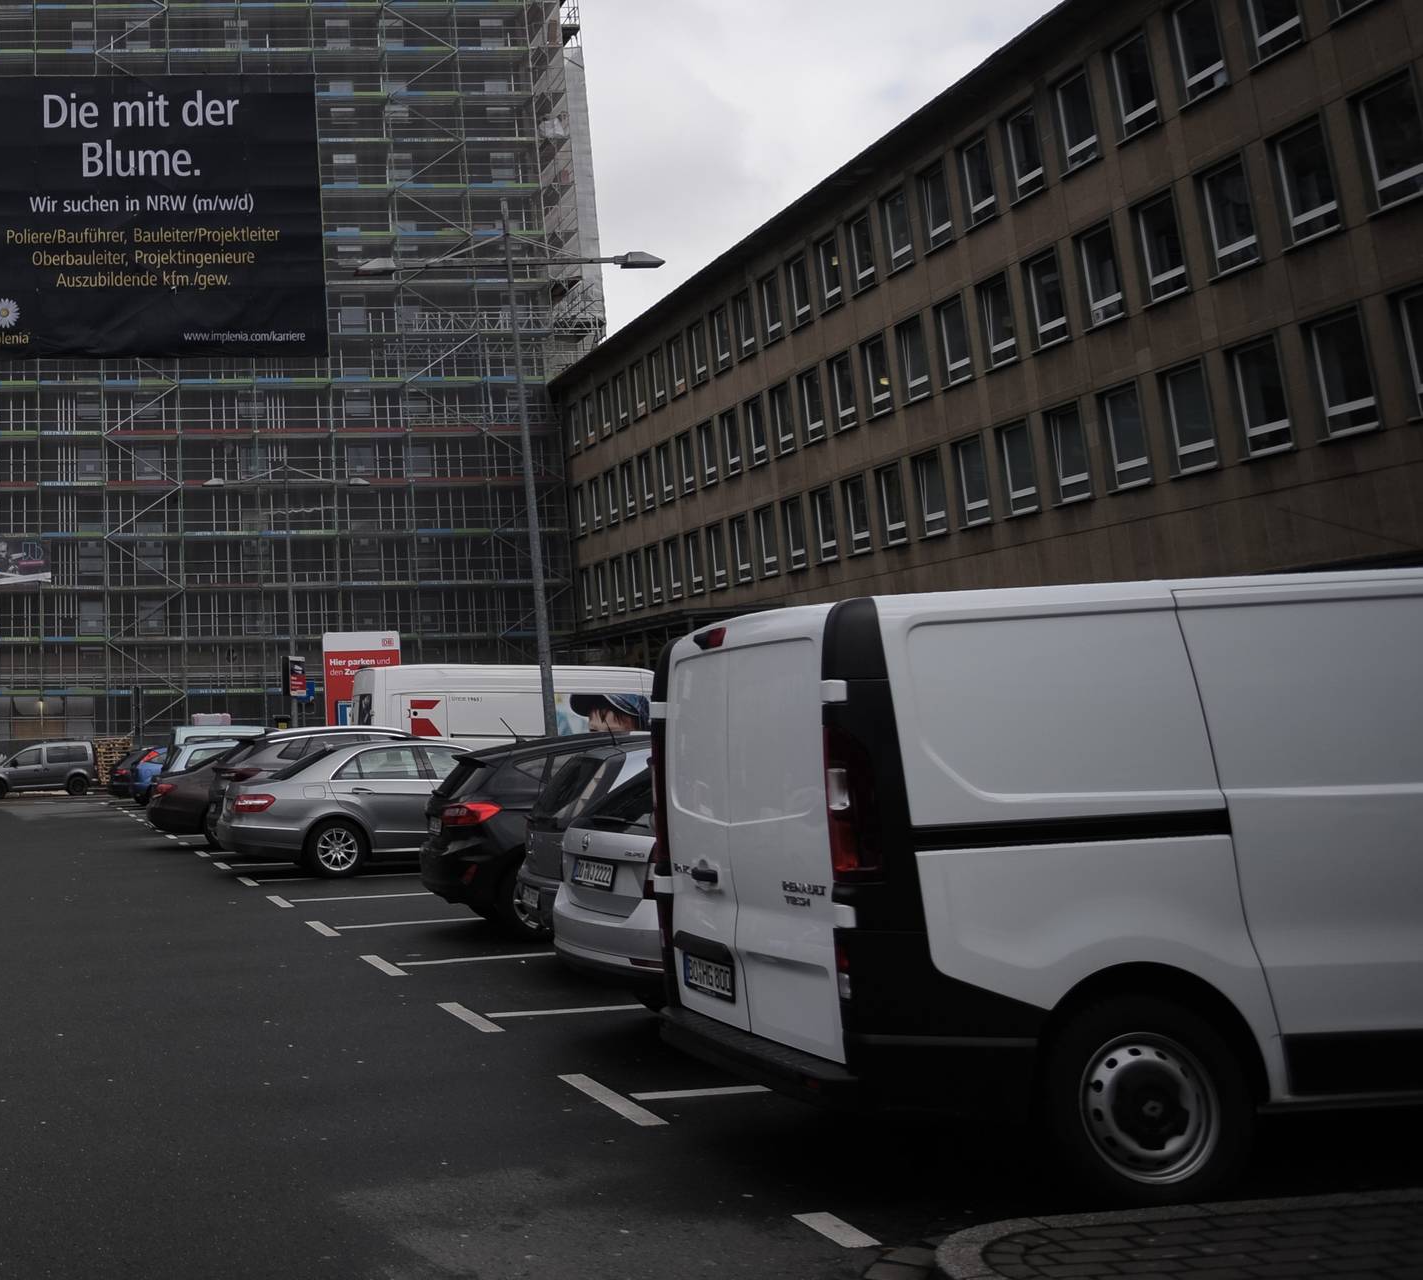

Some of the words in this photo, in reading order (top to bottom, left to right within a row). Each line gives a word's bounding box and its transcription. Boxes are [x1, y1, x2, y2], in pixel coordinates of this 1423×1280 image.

[42, 92, 99, 128] Die
[112, 91, 170, 128] mit
[181, 89, 240, 127] der
[81, 140, 201, 178] Blume.
[29, 196, 58, 212] Wir
[63, 195, 119, 212] suchen
[125, 195, 140, 212] in
[146, 194, 187, 211] NRW
[192, 193, 254, 214] (m/w/d)
[6, 227, 128, 246] Poliere/Bauführer,
[133, 226, 281, 245] Bauleiter/Projektleiter
[32, 249, 127, 267] Oberbauleiter,
[135, 249, 255, 268] Projektingenieure
[56, 271, 158, 288] Auszubildende
[184, 330, 306, 342] www.implenia.com/karriere
[329, 658, 346, 666] Hier
[347, 657, 376, 667] parken
[377, 656, 391, 665] und
[329, 668, 344, 676] den
[344, 668, 355, 676] Zu
